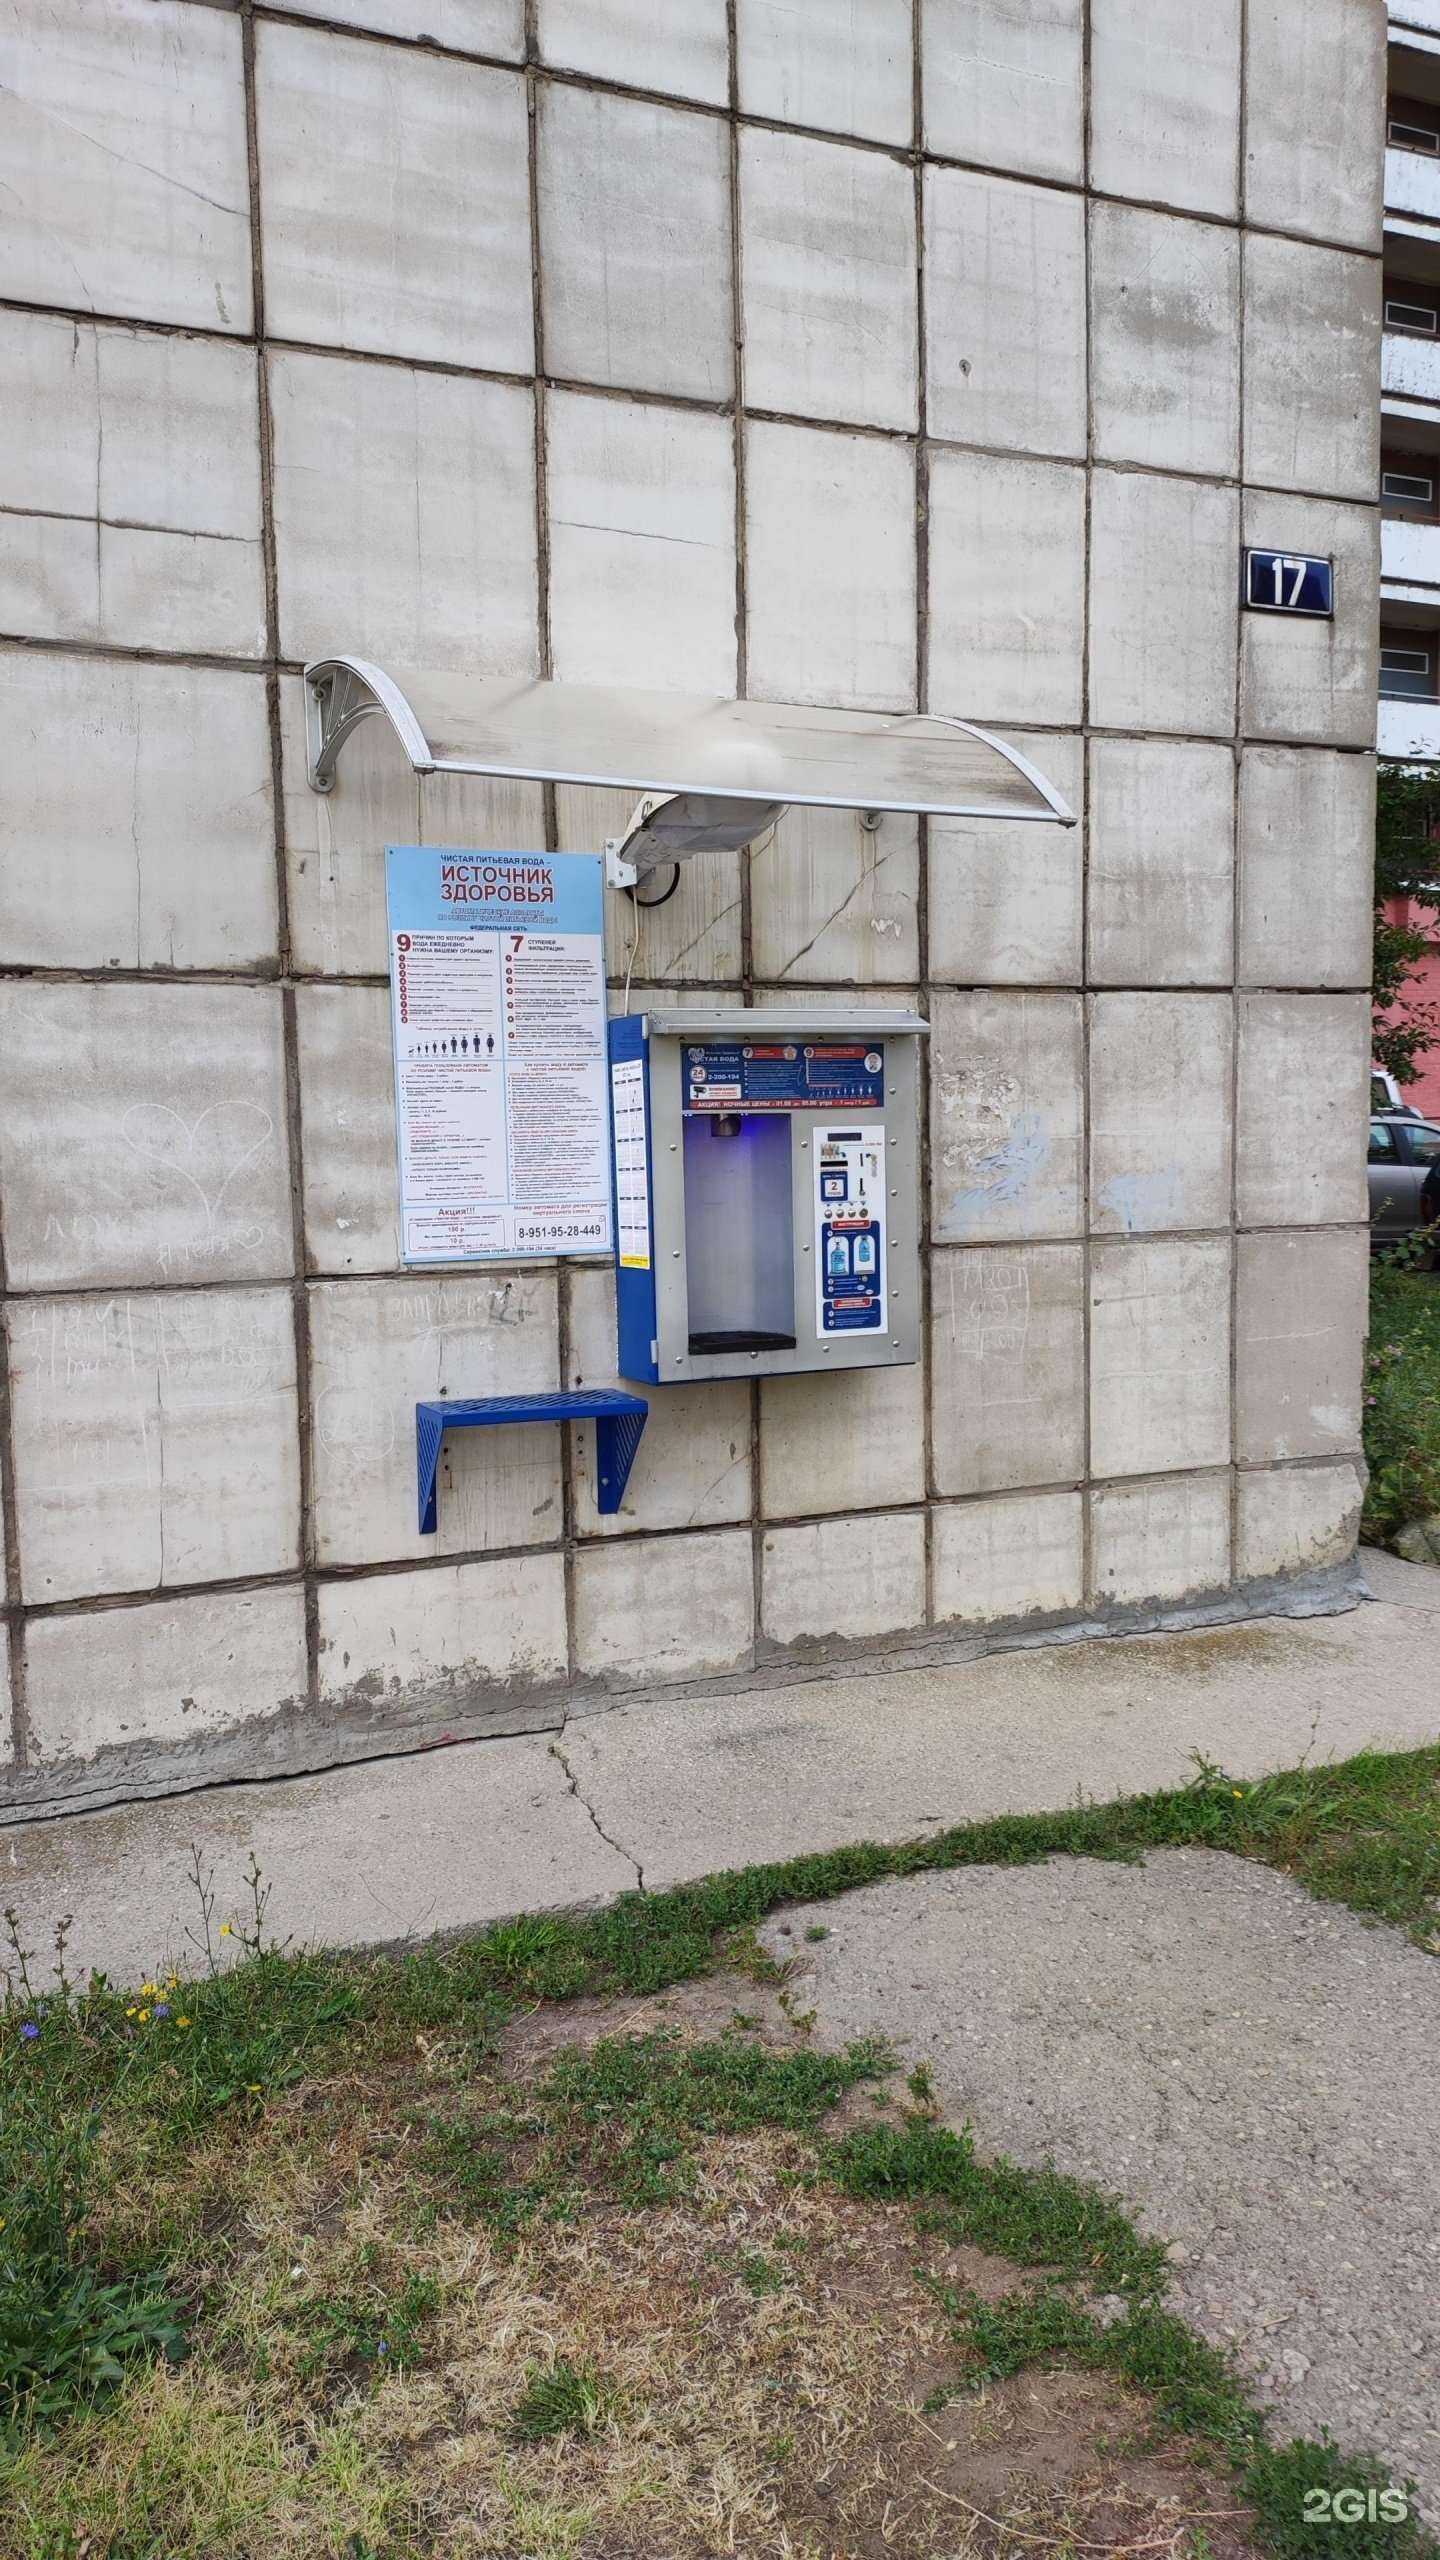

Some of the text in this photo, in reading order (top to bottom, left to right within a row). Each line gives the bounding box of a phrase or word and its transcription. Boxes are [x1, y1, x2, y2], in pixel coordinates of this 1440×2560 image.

[1272, 558, 1306, 606] 17
[441, 855, 545, 866] ЧИСТАЯ ПИТЬЕВАЯ ВОДА
[441, 866, 553, 885] ИСТОЧНИК
[441, 884, 554, 903] ЗДОРОВЬЯ
[397, 934, 411, 952] 9
[510, 935, 524, 953] 7
[831, 1181, 838, 1191] 2
[518, 1224, 601, 1239] 8-951-95-28-449
